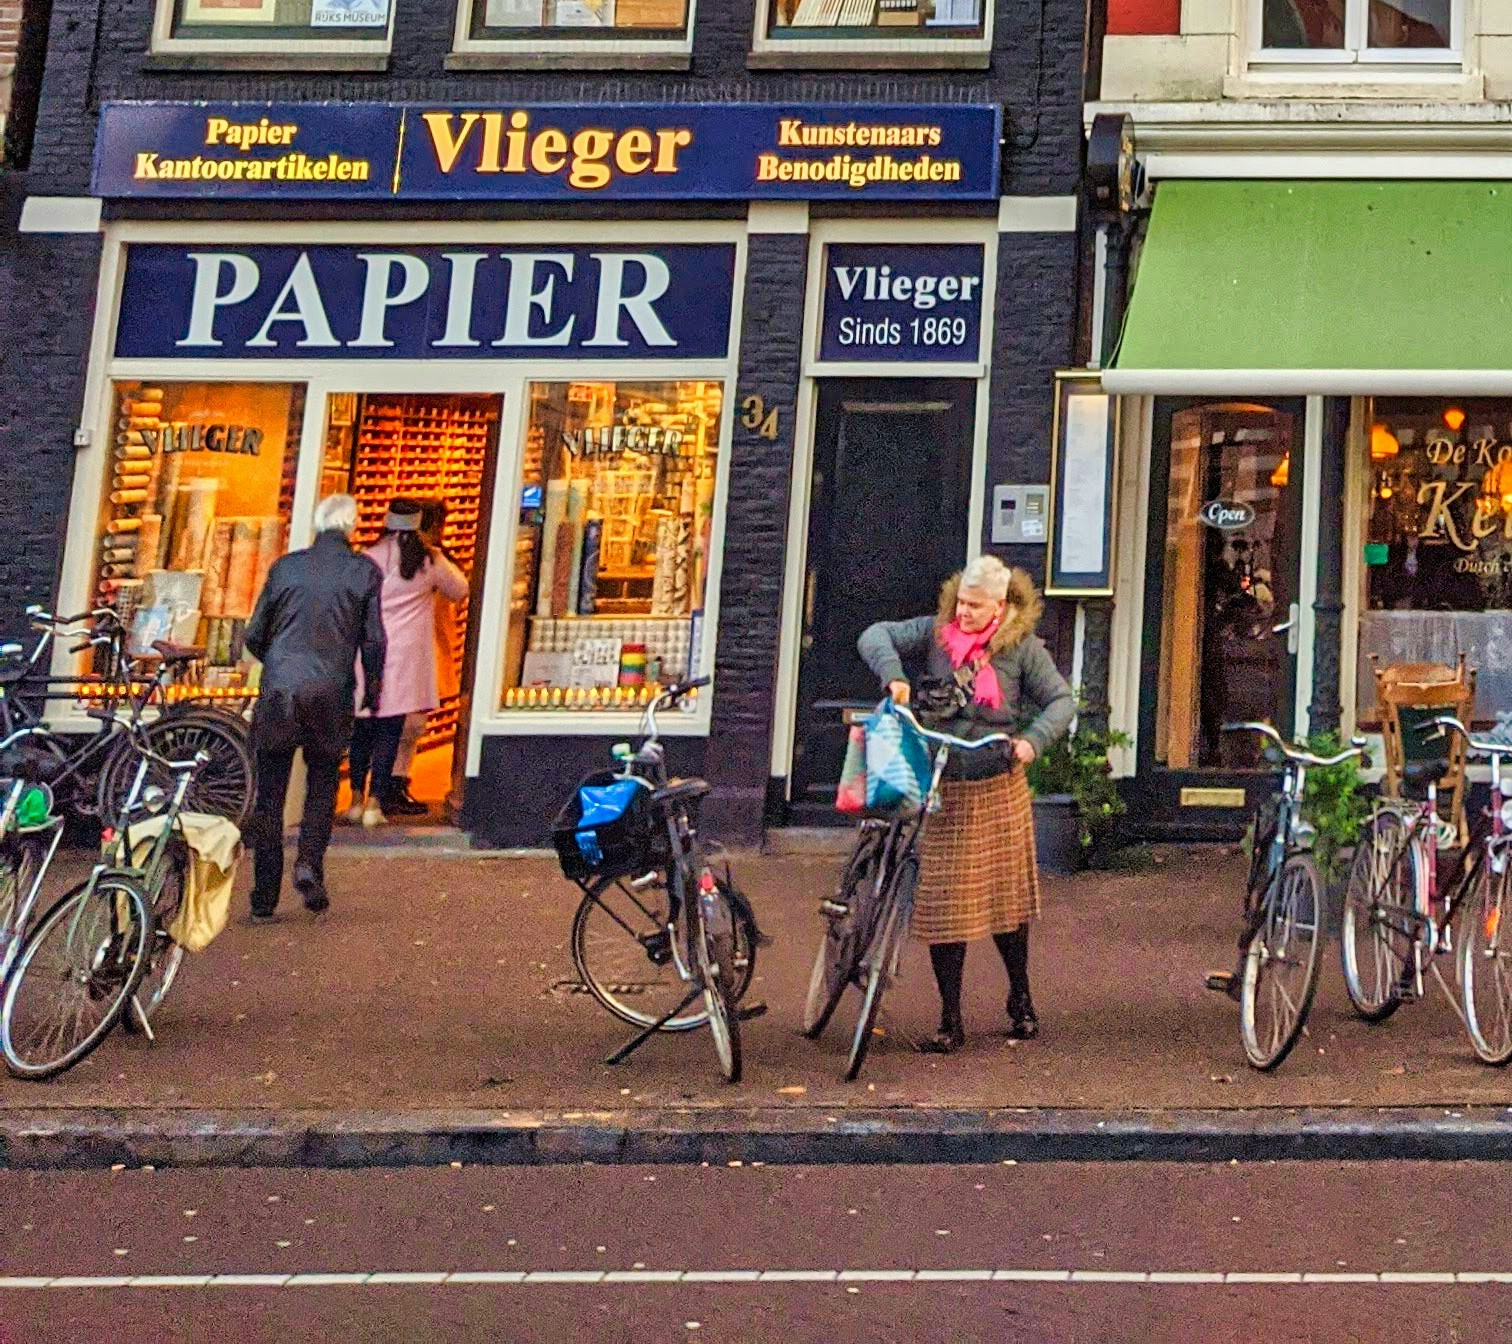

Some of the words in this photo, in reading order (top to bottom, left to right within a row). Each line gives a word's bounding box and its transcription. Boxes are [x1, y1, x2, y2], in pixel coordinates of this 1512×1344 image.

[343, 12, 386, 23] MUSEUM
[205, 118, 297, 150] Papier
[778, 120, 942, 146] Kunstenaars
[422, 111, 691, 188] Vlieger
[133, 153, 369, 182] Kantoorartikelen
[756, 155, 961, 187] Benodigdheden
[175, 251, 677, 348] PAPIER
[833, 266, 980, 310] Vlieger
[838, 317, 901, 346] Sinds
[910, 317, 967, 345] 1869
[741, 395, 779, 441] 34
[140, 424, 264, 456] VLIEGER
[562, 425, 683, 456] VLIEGER
[1426, 438, 1466, 464] De
[1207, 502, 1247, 523] Open
[1454, 559, 1500, 574] Dutch
